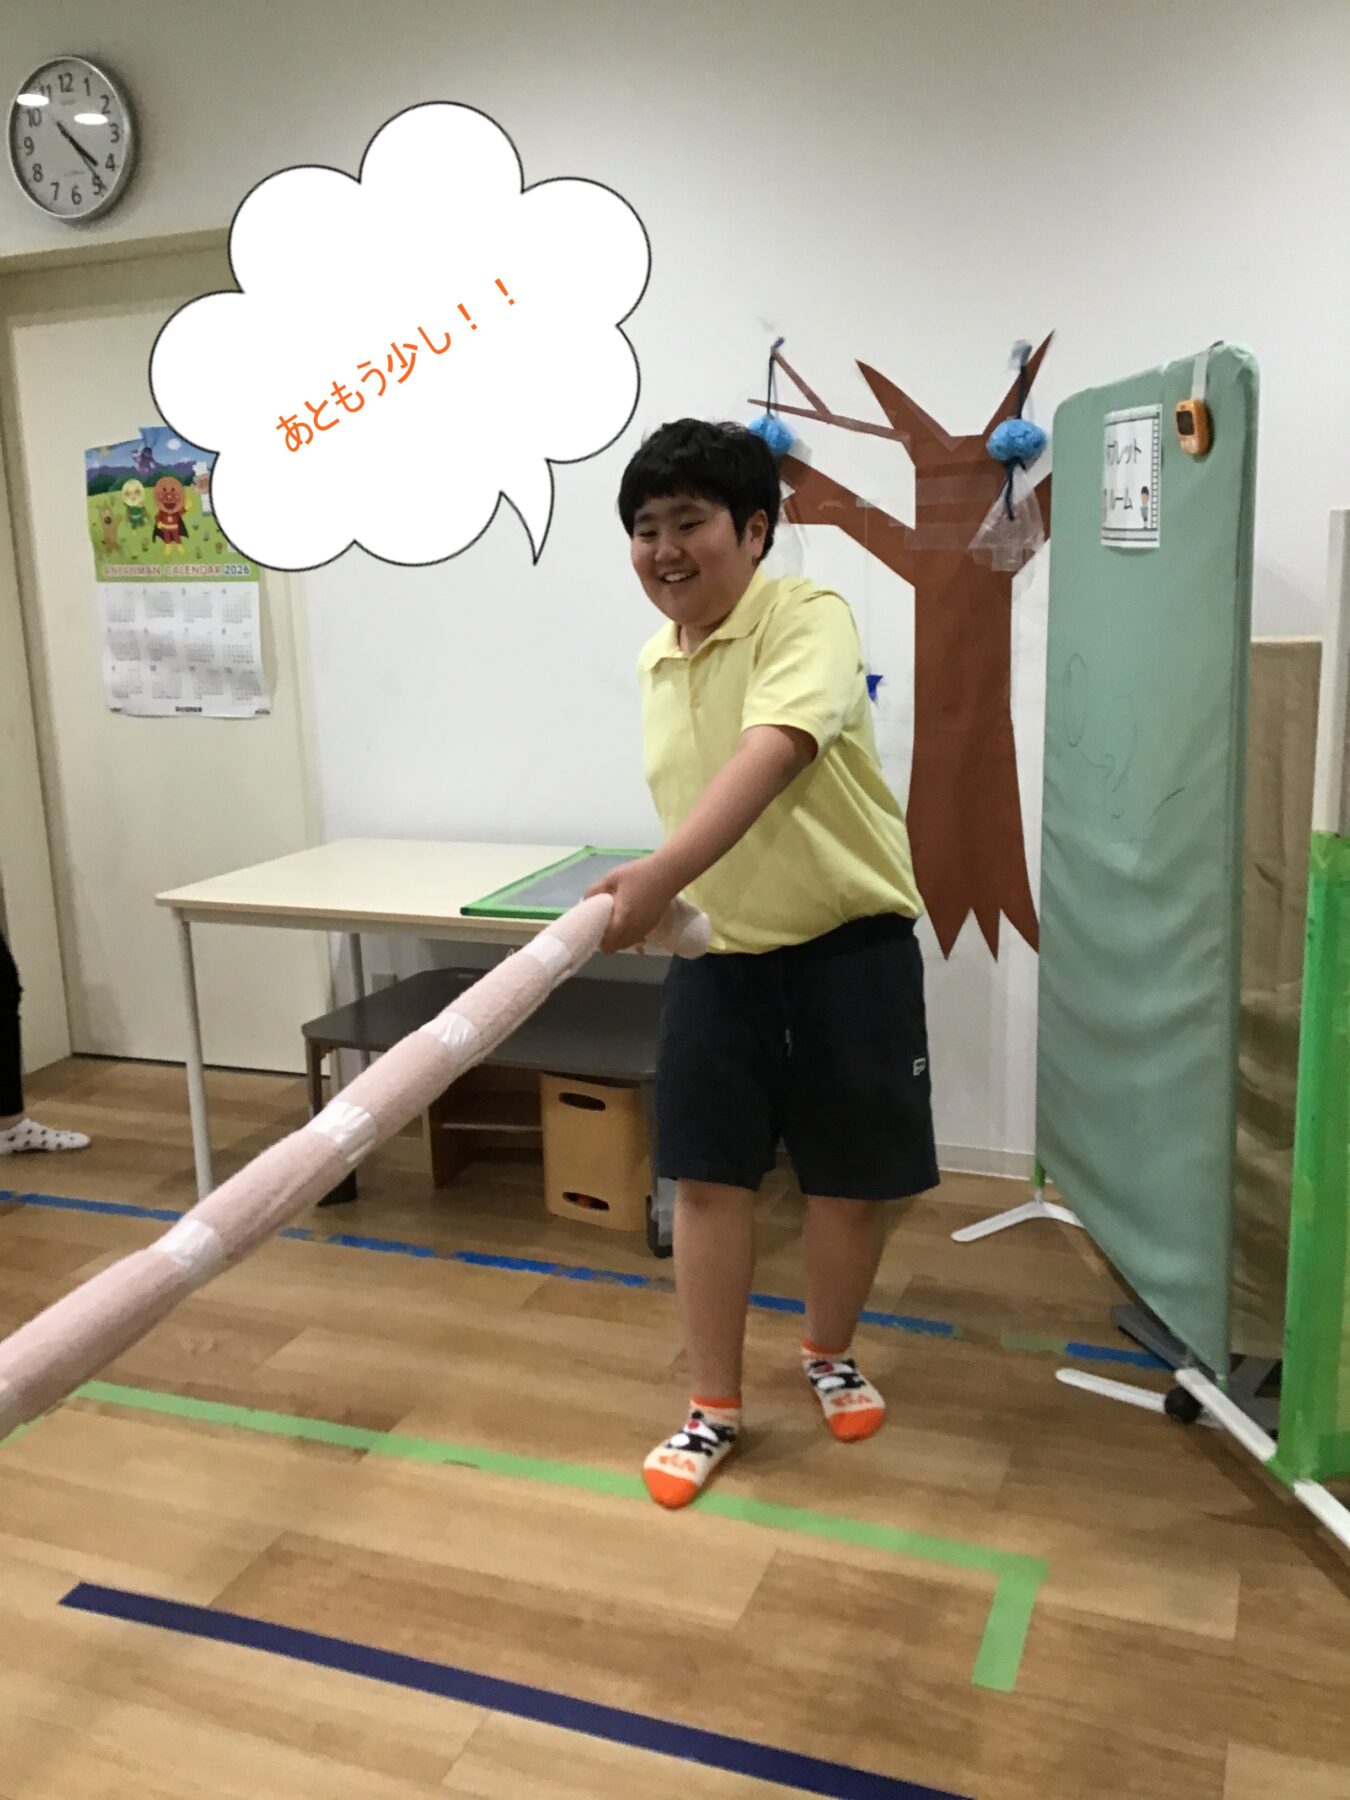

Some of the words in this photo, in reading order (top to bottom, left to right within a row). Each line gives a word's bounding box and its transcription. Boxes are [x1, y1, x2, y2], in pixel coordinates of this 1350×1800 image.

[58, 72, 74, 93] 12
[84, 77, 91, 97] 1
[100, 94, 111, 114] 2
[26, 107, 42, 128] 10
[109, 123, 120, 143] 3
[23, 136, 35, 156] 9
[105, 153, 116, 172] 4
[32, 163, 44, 183] 8
[50, 182, 60, 201] 7
[92, 174, 103, 195] 5
[71, 185, 82, 205] 6
[224, 564, 250, 575] 2026
